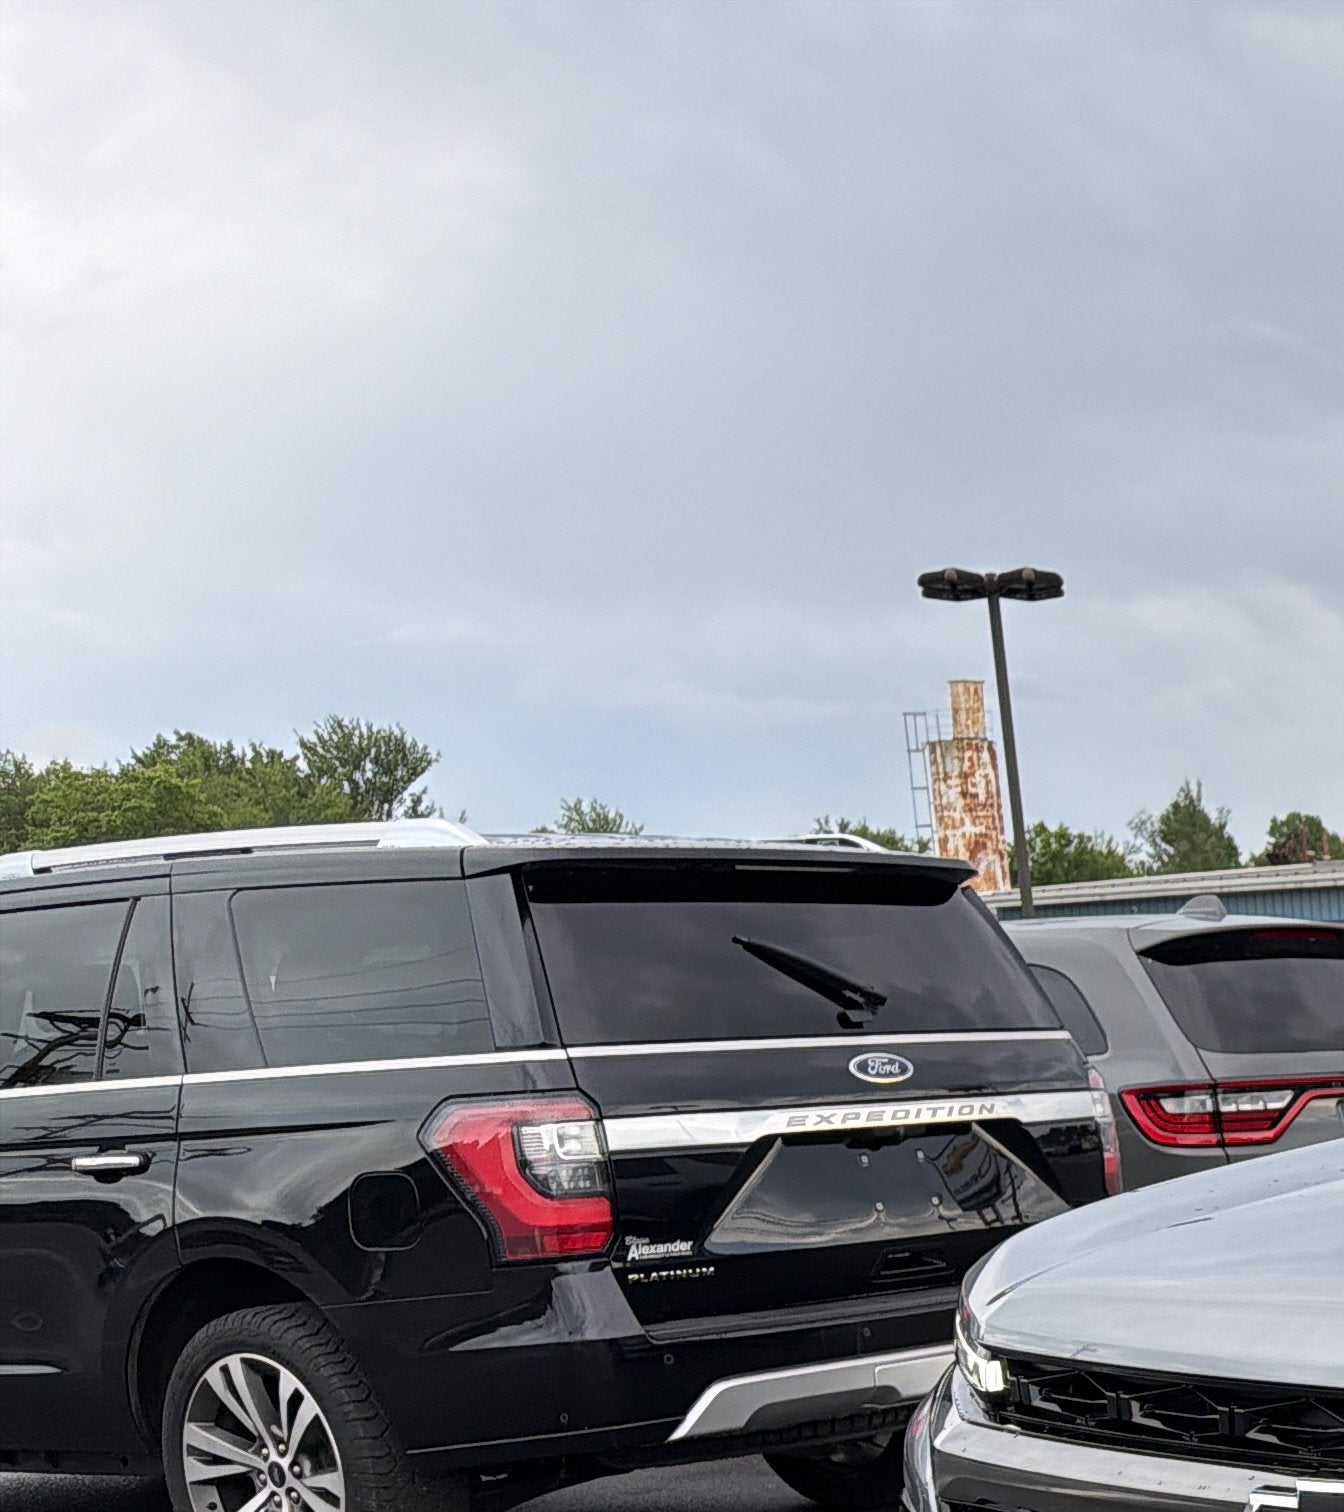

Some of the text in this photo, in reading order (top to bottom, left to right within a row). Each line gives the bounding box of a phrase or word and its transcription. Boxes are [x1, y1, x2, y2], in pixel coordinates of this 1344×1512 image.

[867, 1058, 901, 1075] Ford
[786, 1103, 996, 1128] EXPEDITION
[627, 1239, 694, 1261] Alexander
[627, 1266, 715, 1284] PLATINUM
